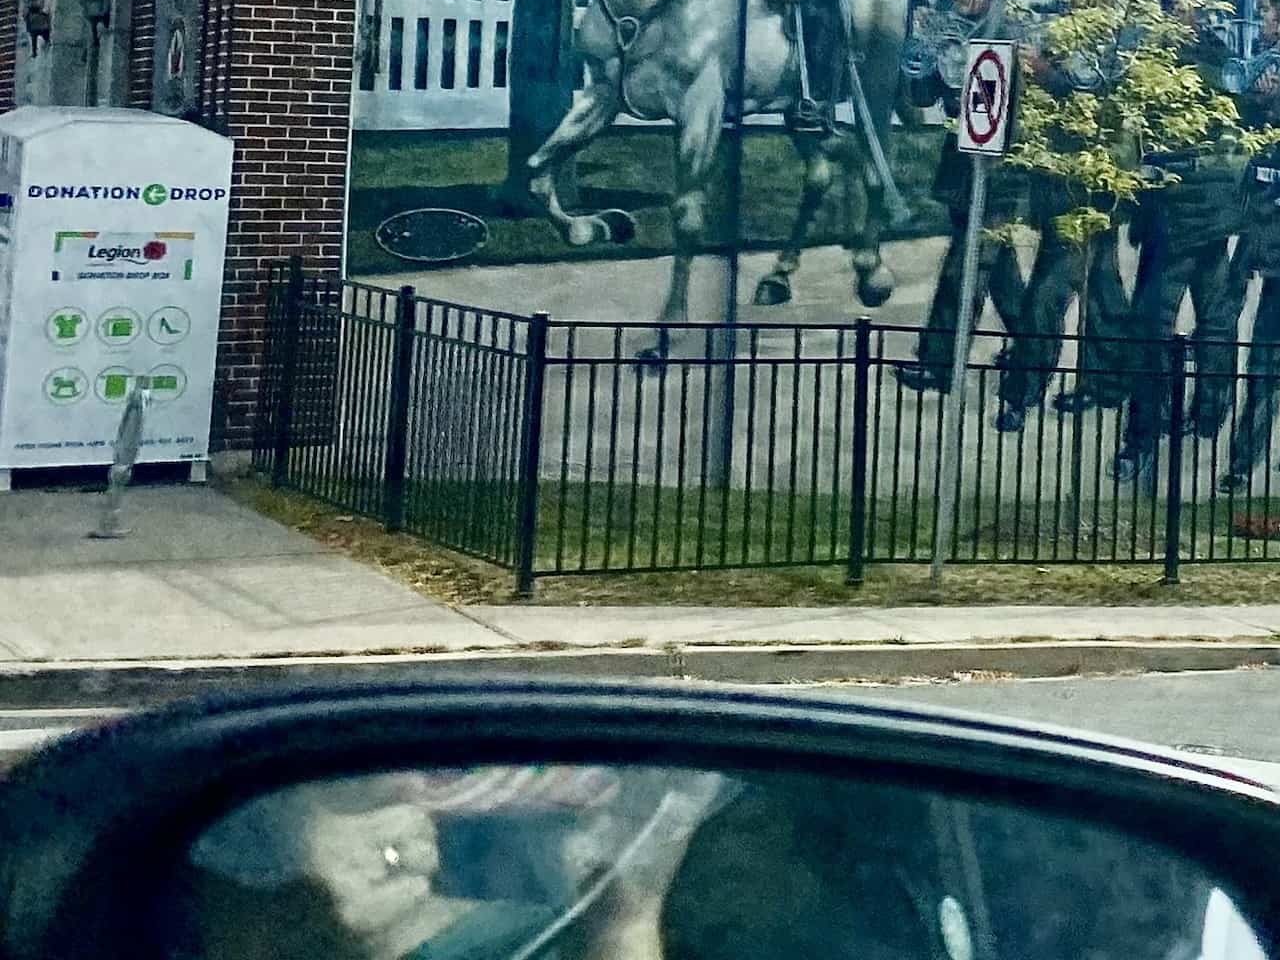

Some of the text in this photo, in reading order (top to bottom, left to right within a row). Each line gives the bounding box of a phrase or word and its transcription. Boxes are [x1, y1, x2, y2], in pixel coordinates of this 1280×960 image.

[28, 185, 226, 201] DONATION DROP
[88, 244, 141, 262] Legion
